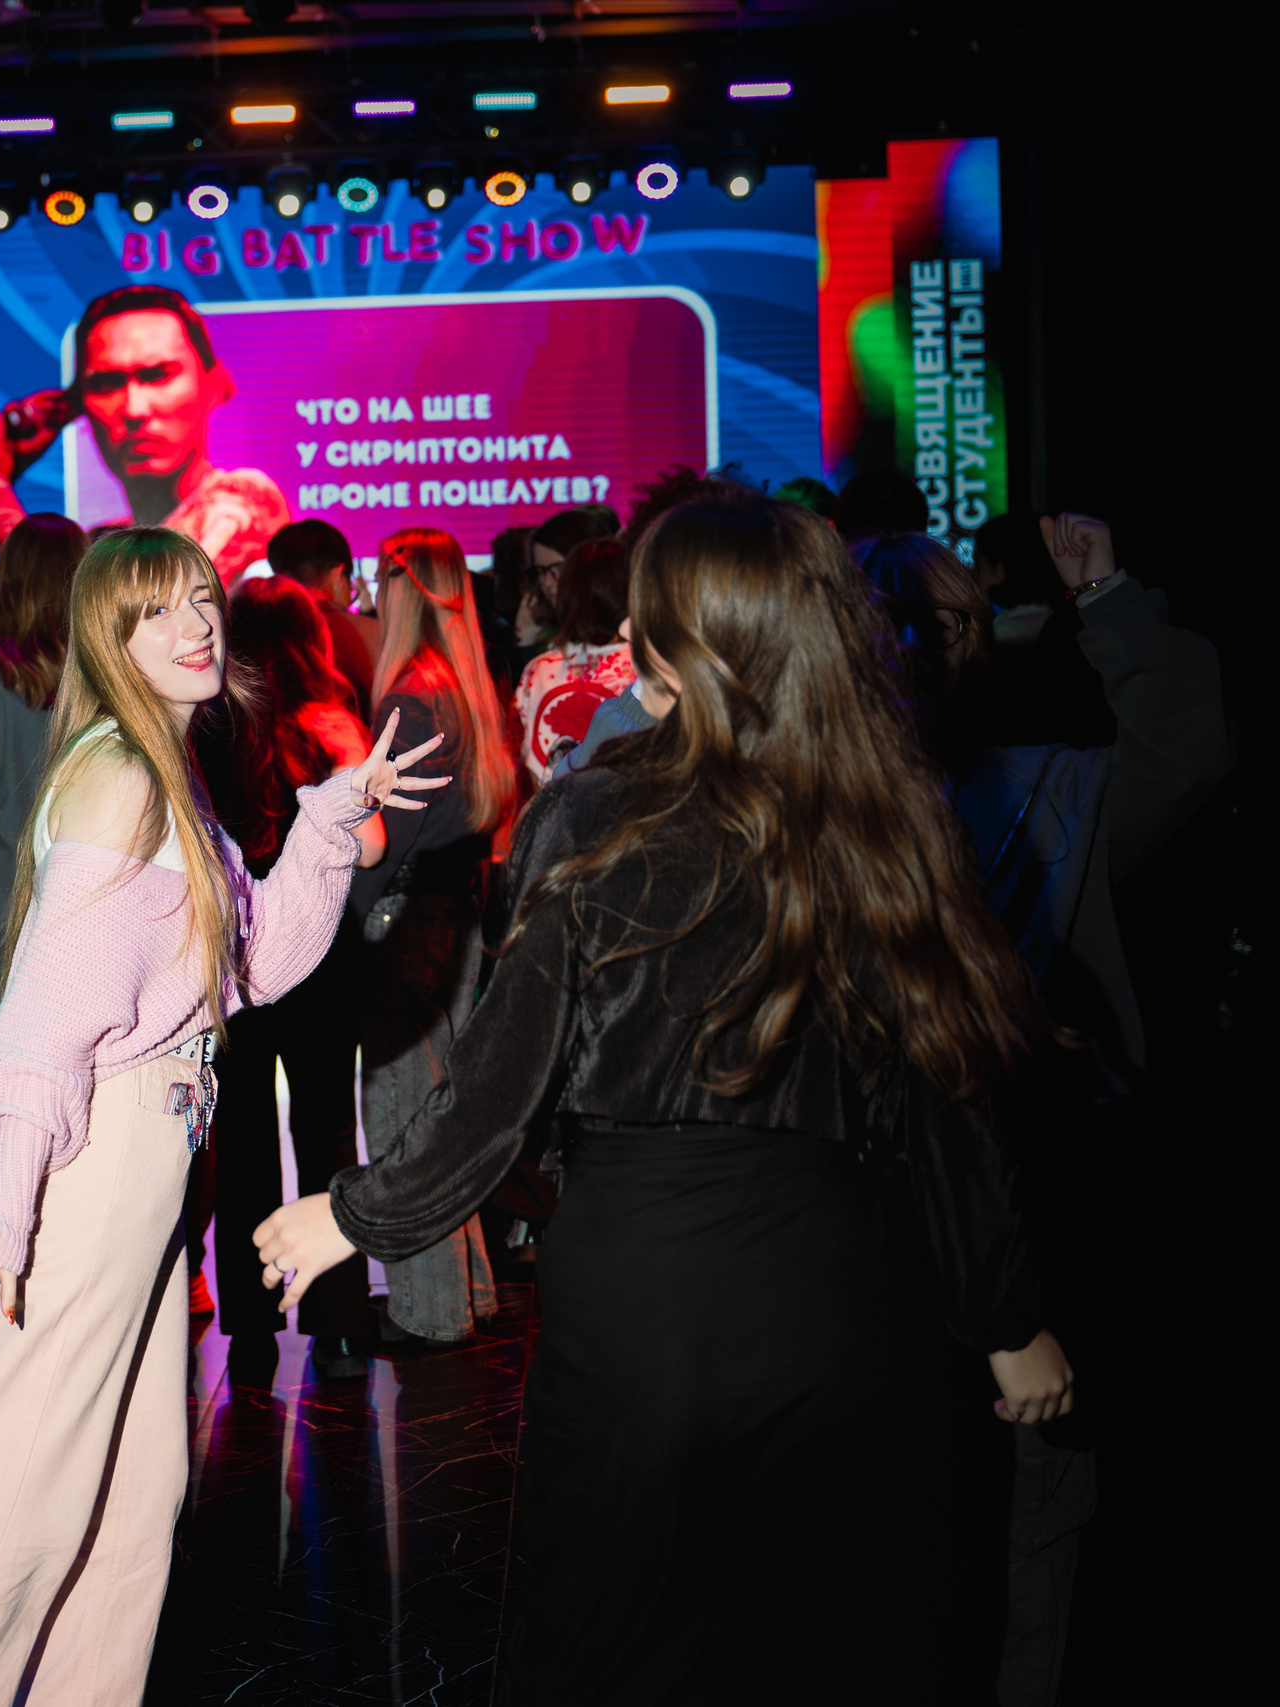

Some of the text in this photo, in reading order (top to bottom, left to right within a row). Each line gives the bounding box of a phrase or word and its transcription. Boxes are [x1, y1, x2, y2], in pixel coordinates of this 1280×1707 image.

[120, 213, 646, 275] BIG BATTLE SHOW
[295, 393, 492, 425] ЧТО НА ШЕЕ
[950, 293, 994, 530] СТУДЕНТЫ
[296, 433, 572, 468] У СКРИПТОНИТА
[298, 474, 610, 510] КРОМЕ ПОЦЕЛУЕВ?
